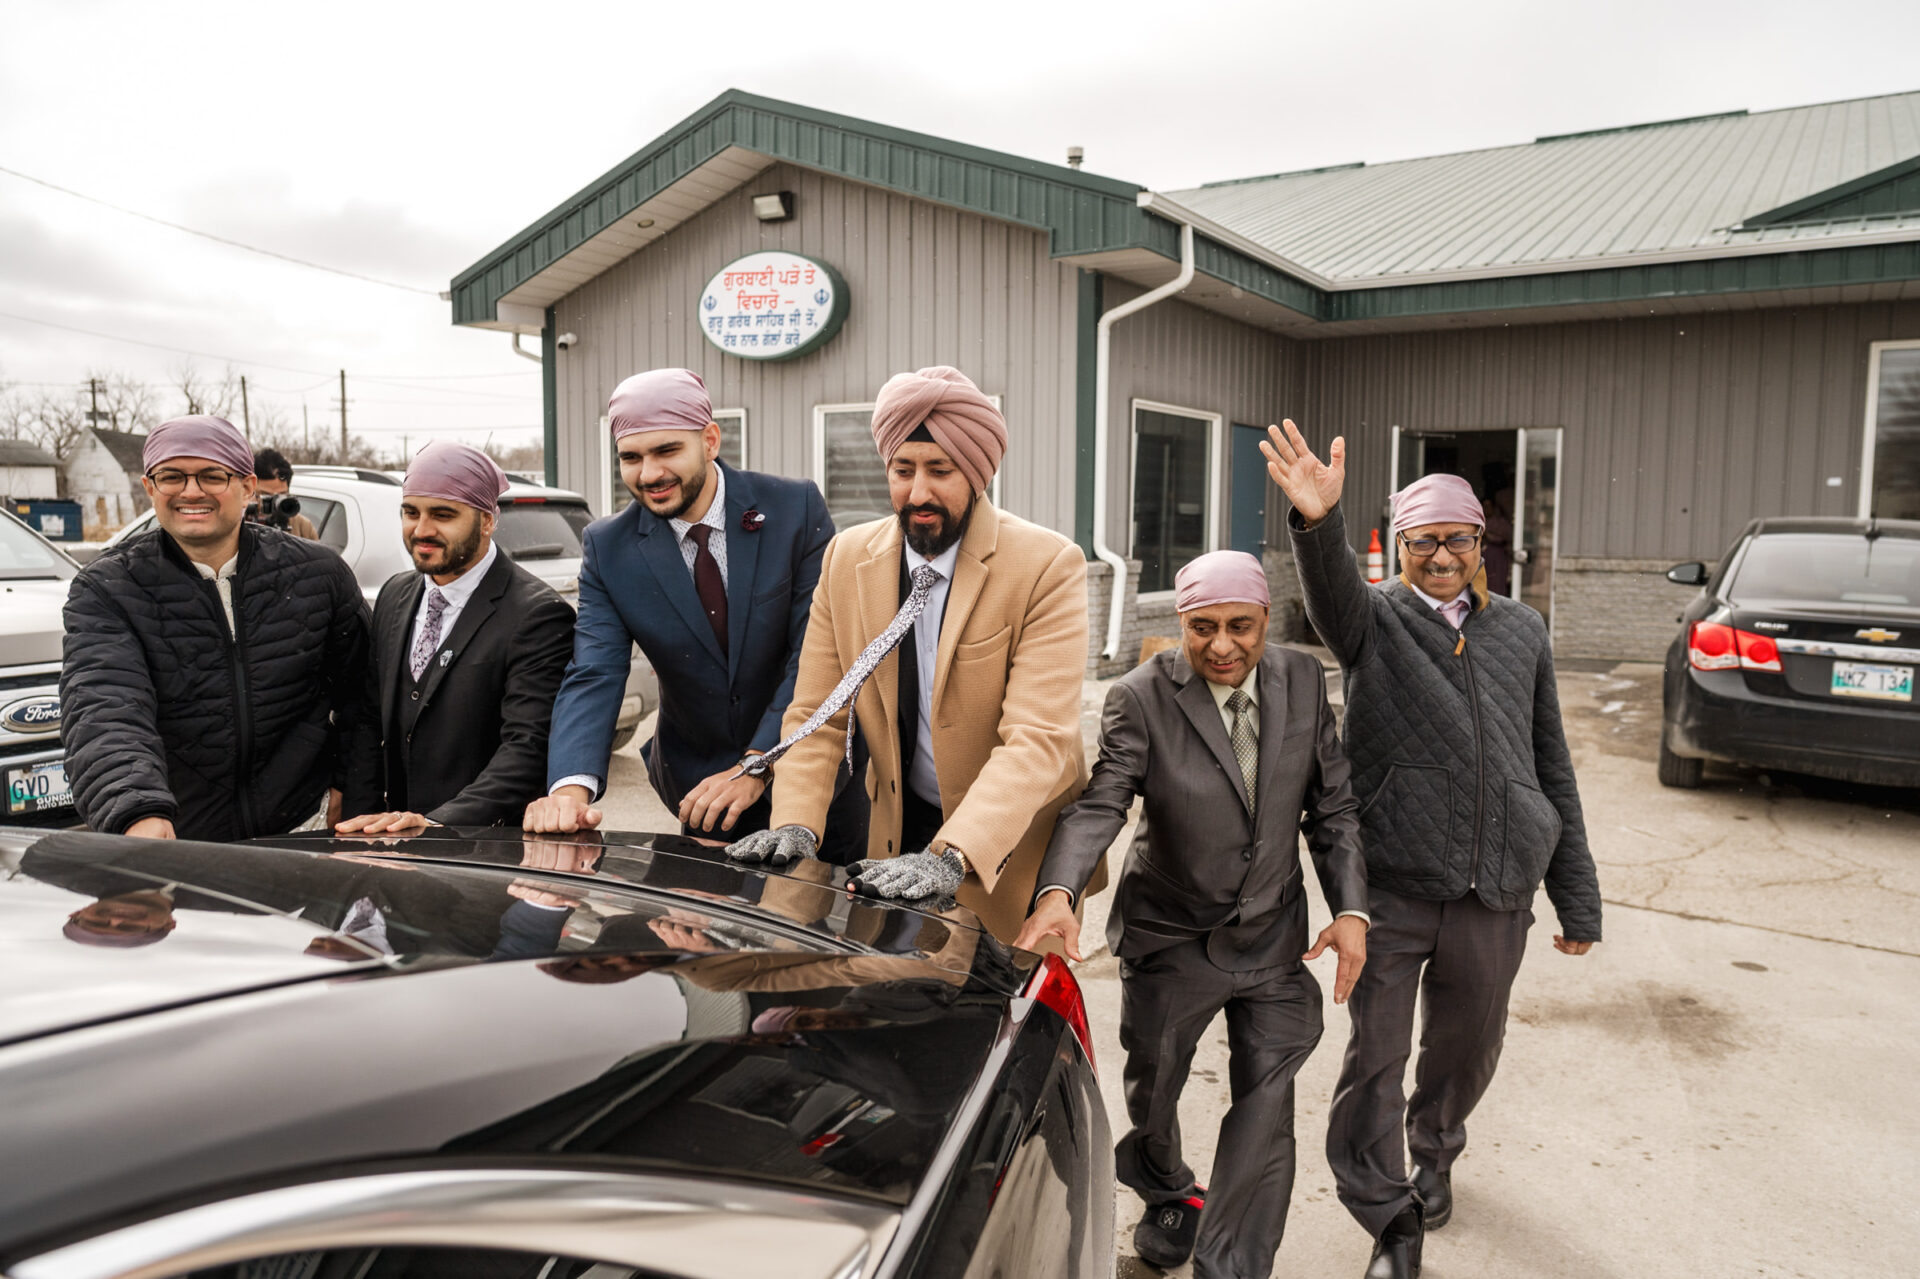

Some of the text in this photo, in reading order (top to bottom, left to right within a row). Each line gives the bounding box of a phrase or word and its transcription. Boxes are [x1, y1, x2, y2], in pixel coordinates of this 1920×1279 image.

[723, 265, 774, 291] ਗੁਰਬਾਣੀ
[804, 263, 816, 285] ਤੇ
[737, 289, 780, 311] ਵਿਚਾਰੋ
[24, 703, 62, 721] Ford
[12, 774, 49, 801] GVD
[36, 801, 57, 811] AUTO
